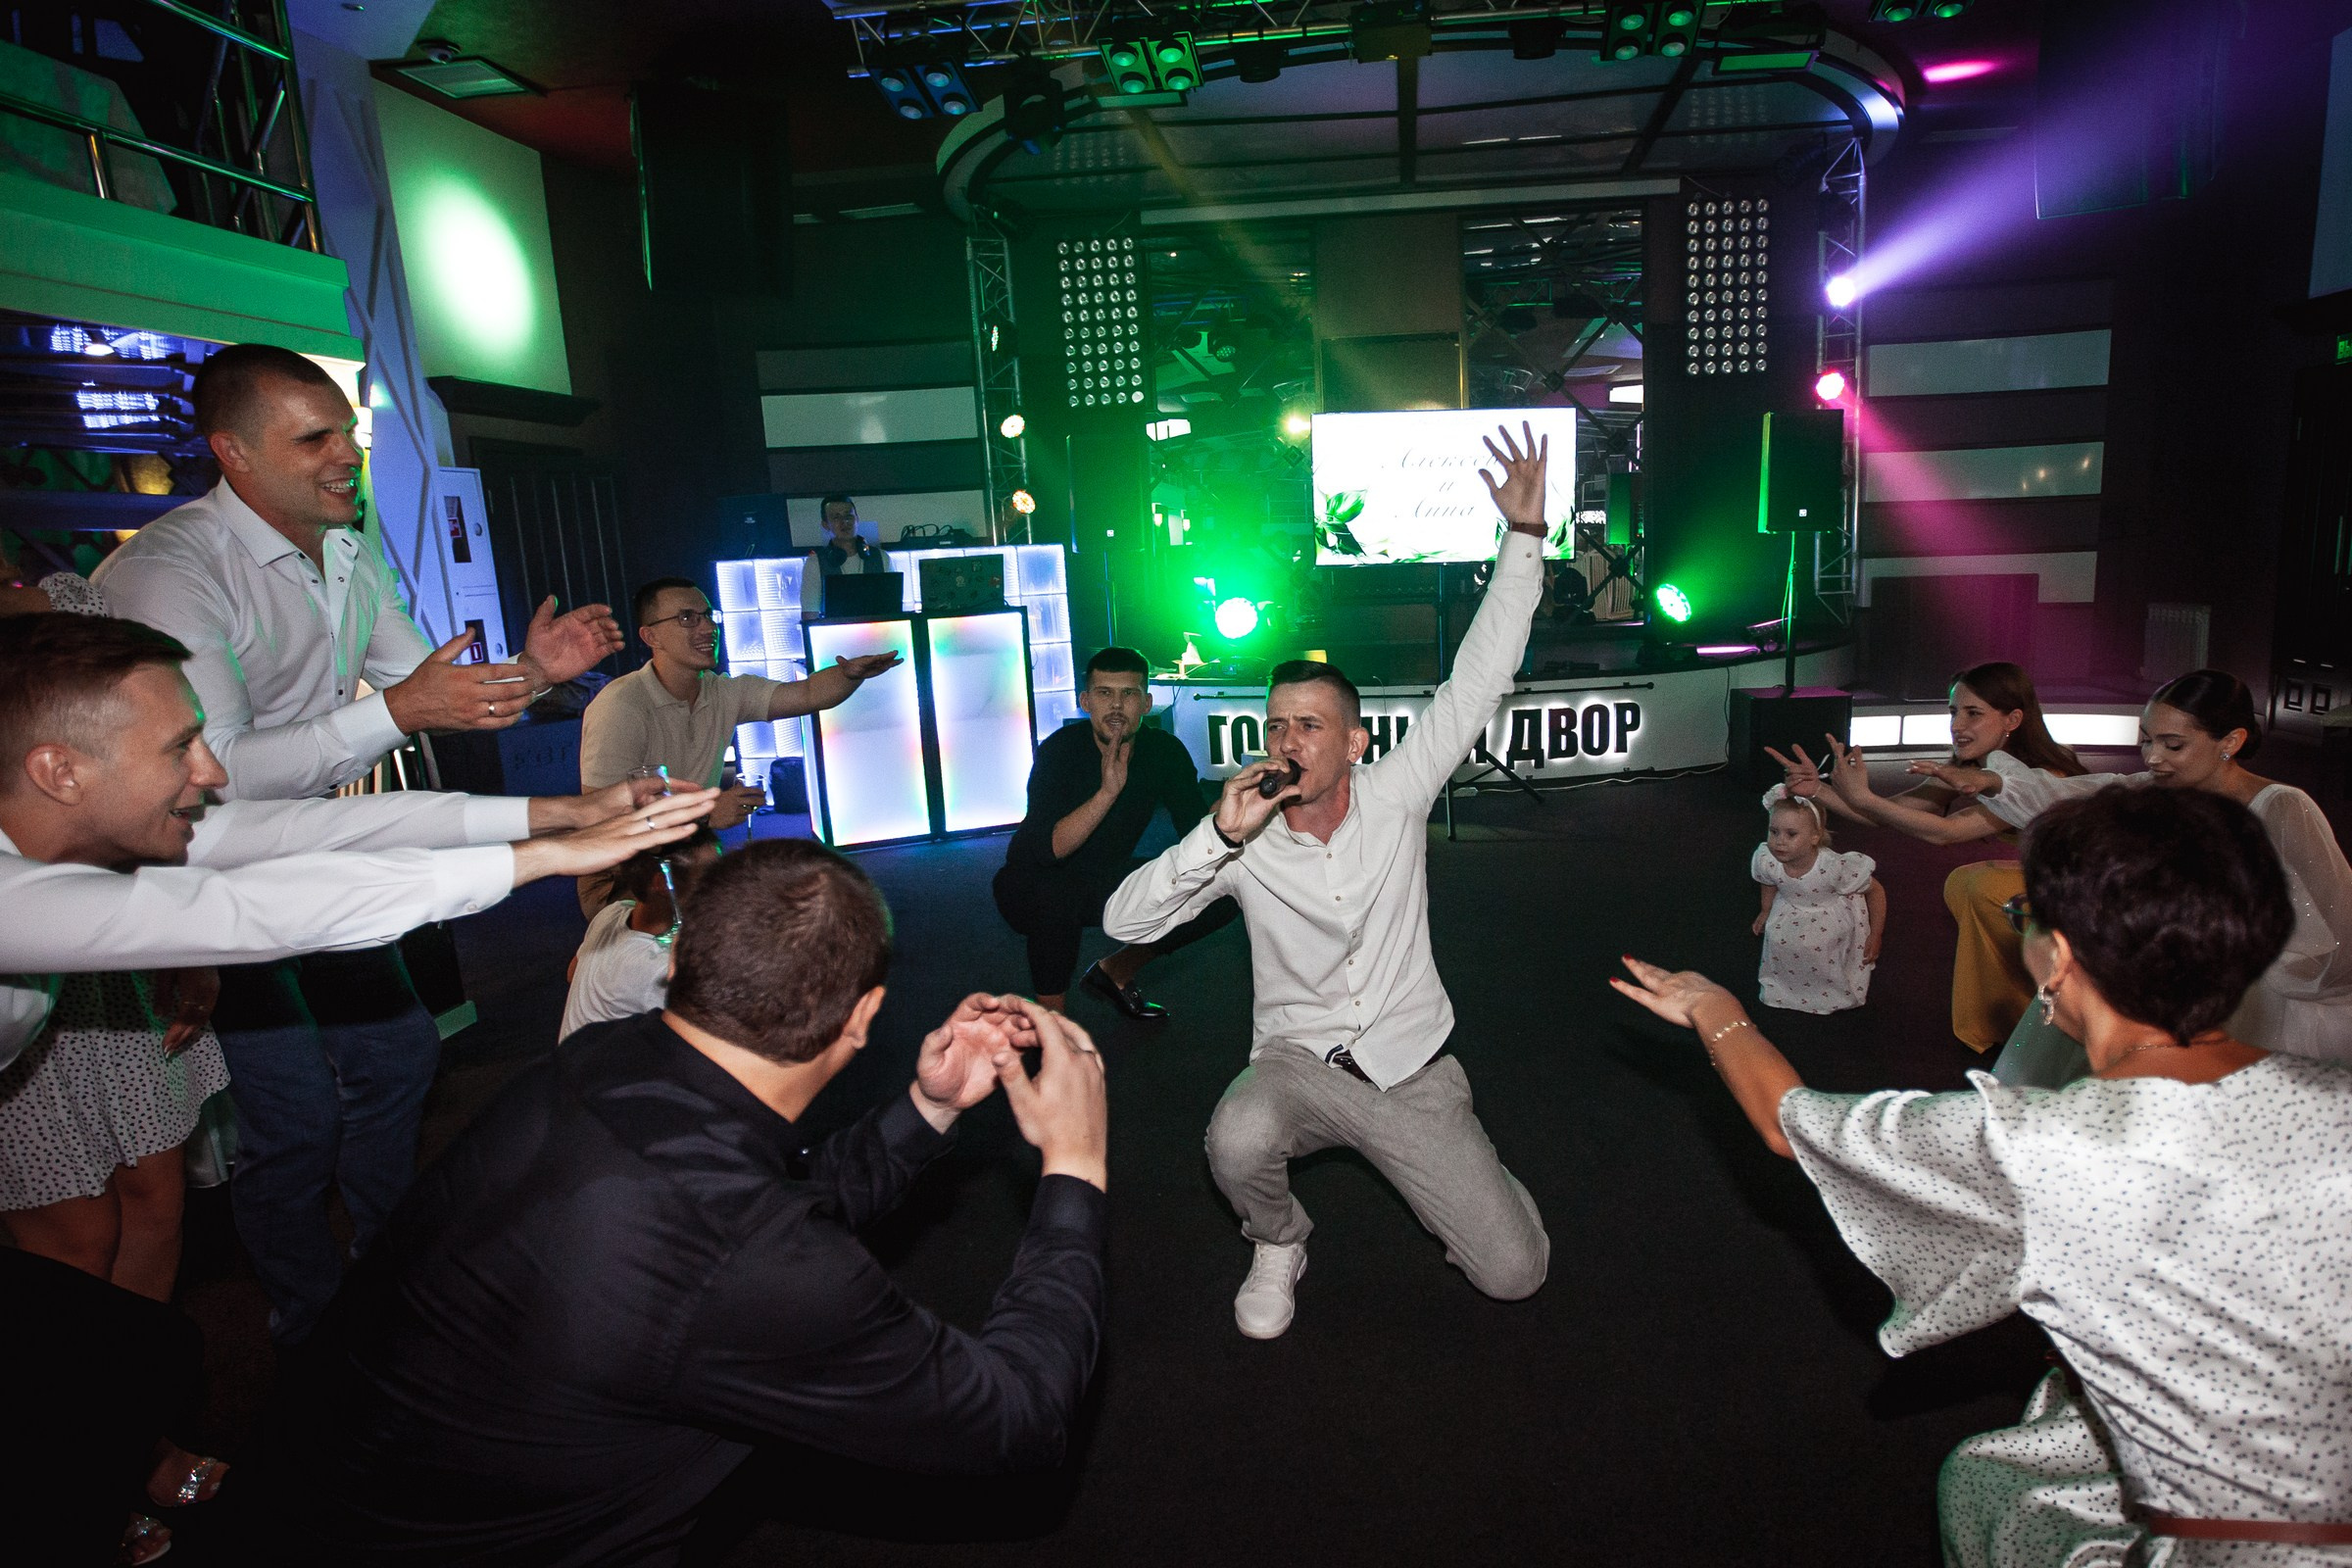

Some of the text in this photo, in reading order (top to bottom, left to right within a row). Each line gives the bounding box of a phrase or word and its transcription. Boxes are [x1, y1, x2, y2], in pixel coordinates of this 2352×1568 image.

[1438, 480, 1456, 493] и
[1394, 497, 1475, 518] Анна
[1506, 702, 1641, 770] ДВОР
